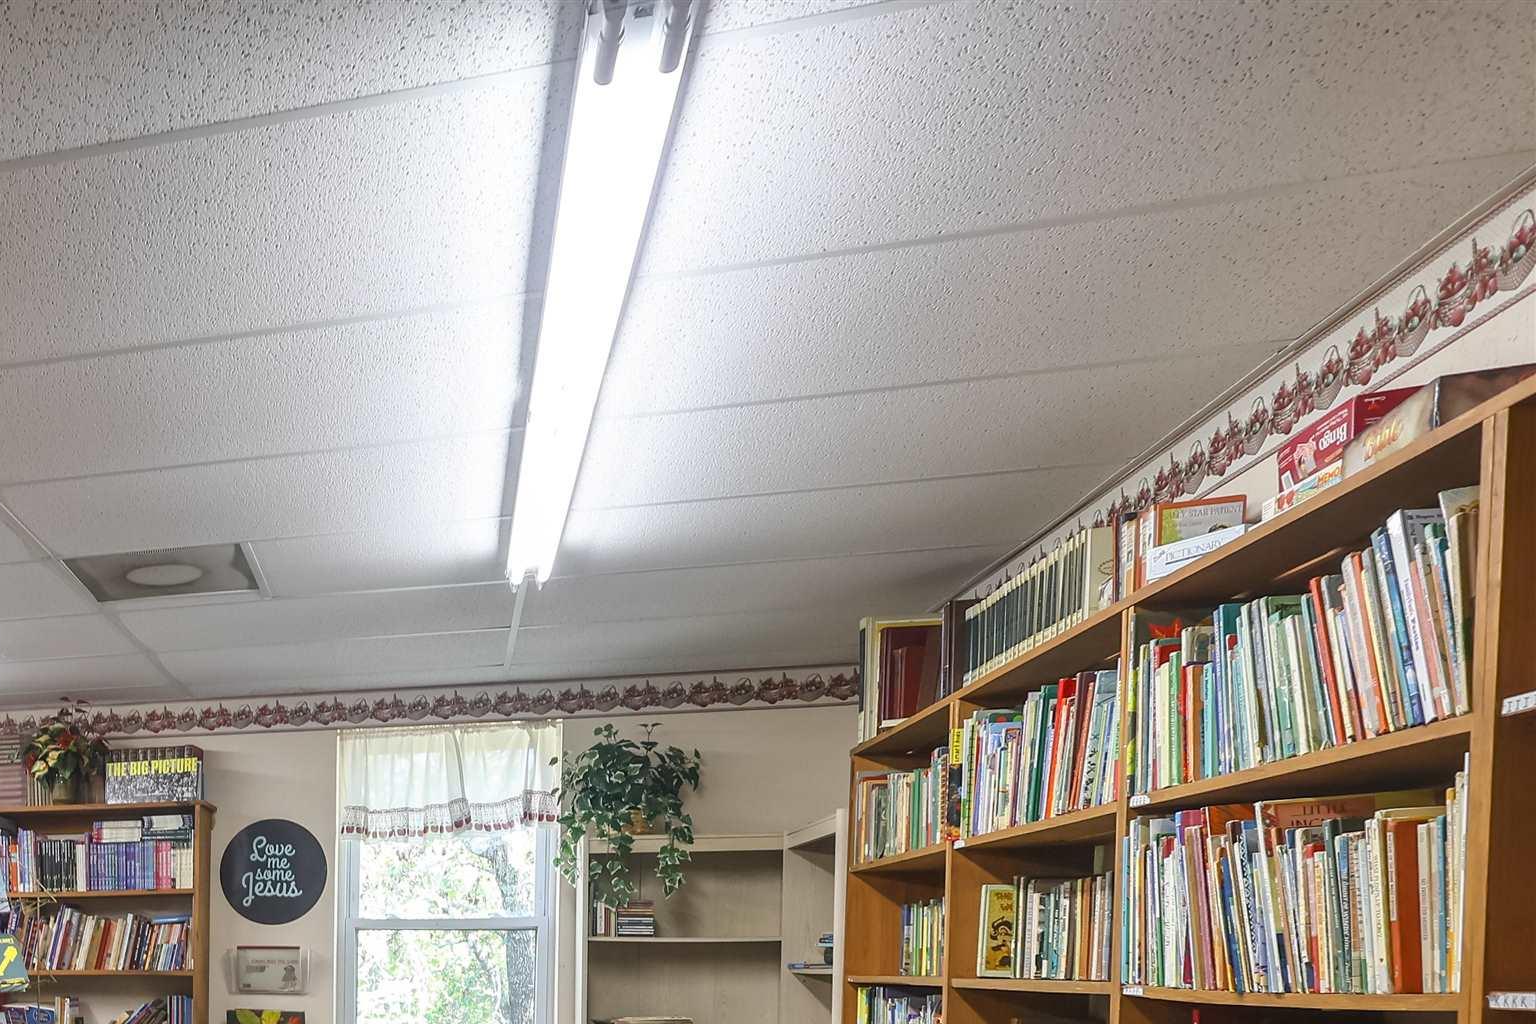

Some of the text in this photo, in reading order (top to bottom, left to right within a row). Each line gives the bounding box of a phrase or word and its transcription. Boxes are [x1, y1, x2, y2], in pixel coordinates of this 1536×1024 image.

[1319, 422, 1348, 451] Bingo
[107, 757, 198, 776] THE BIG PICTURE
[250, 836, 295, 861] Love
[267, 857, 290, 868] me
[255, 868, 295, 881] some
[242, 872, 302, 906] Jesus
